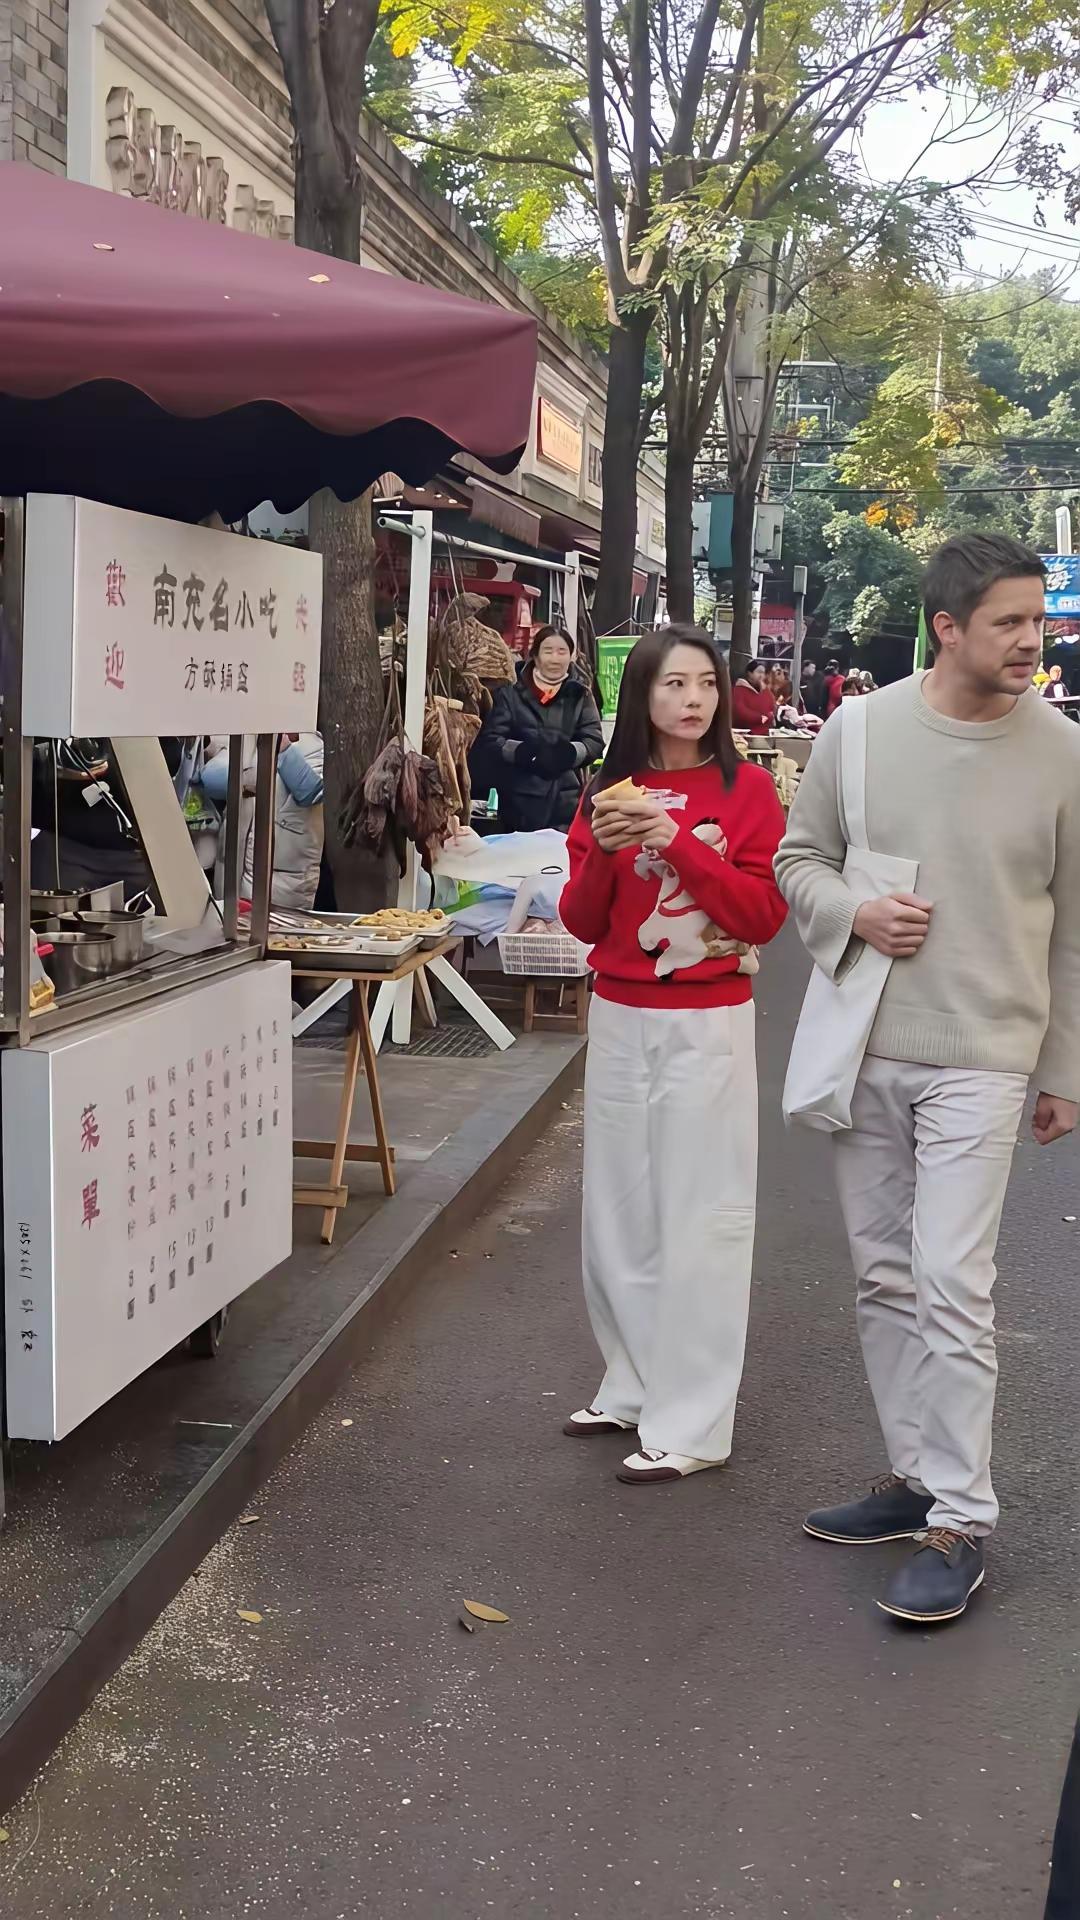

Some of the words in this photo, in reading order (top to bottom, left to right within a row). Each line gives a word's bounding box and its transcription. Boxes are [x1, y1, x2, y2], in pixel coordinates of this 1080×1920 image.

[153, 562, 278, 640] 南充名小吃
